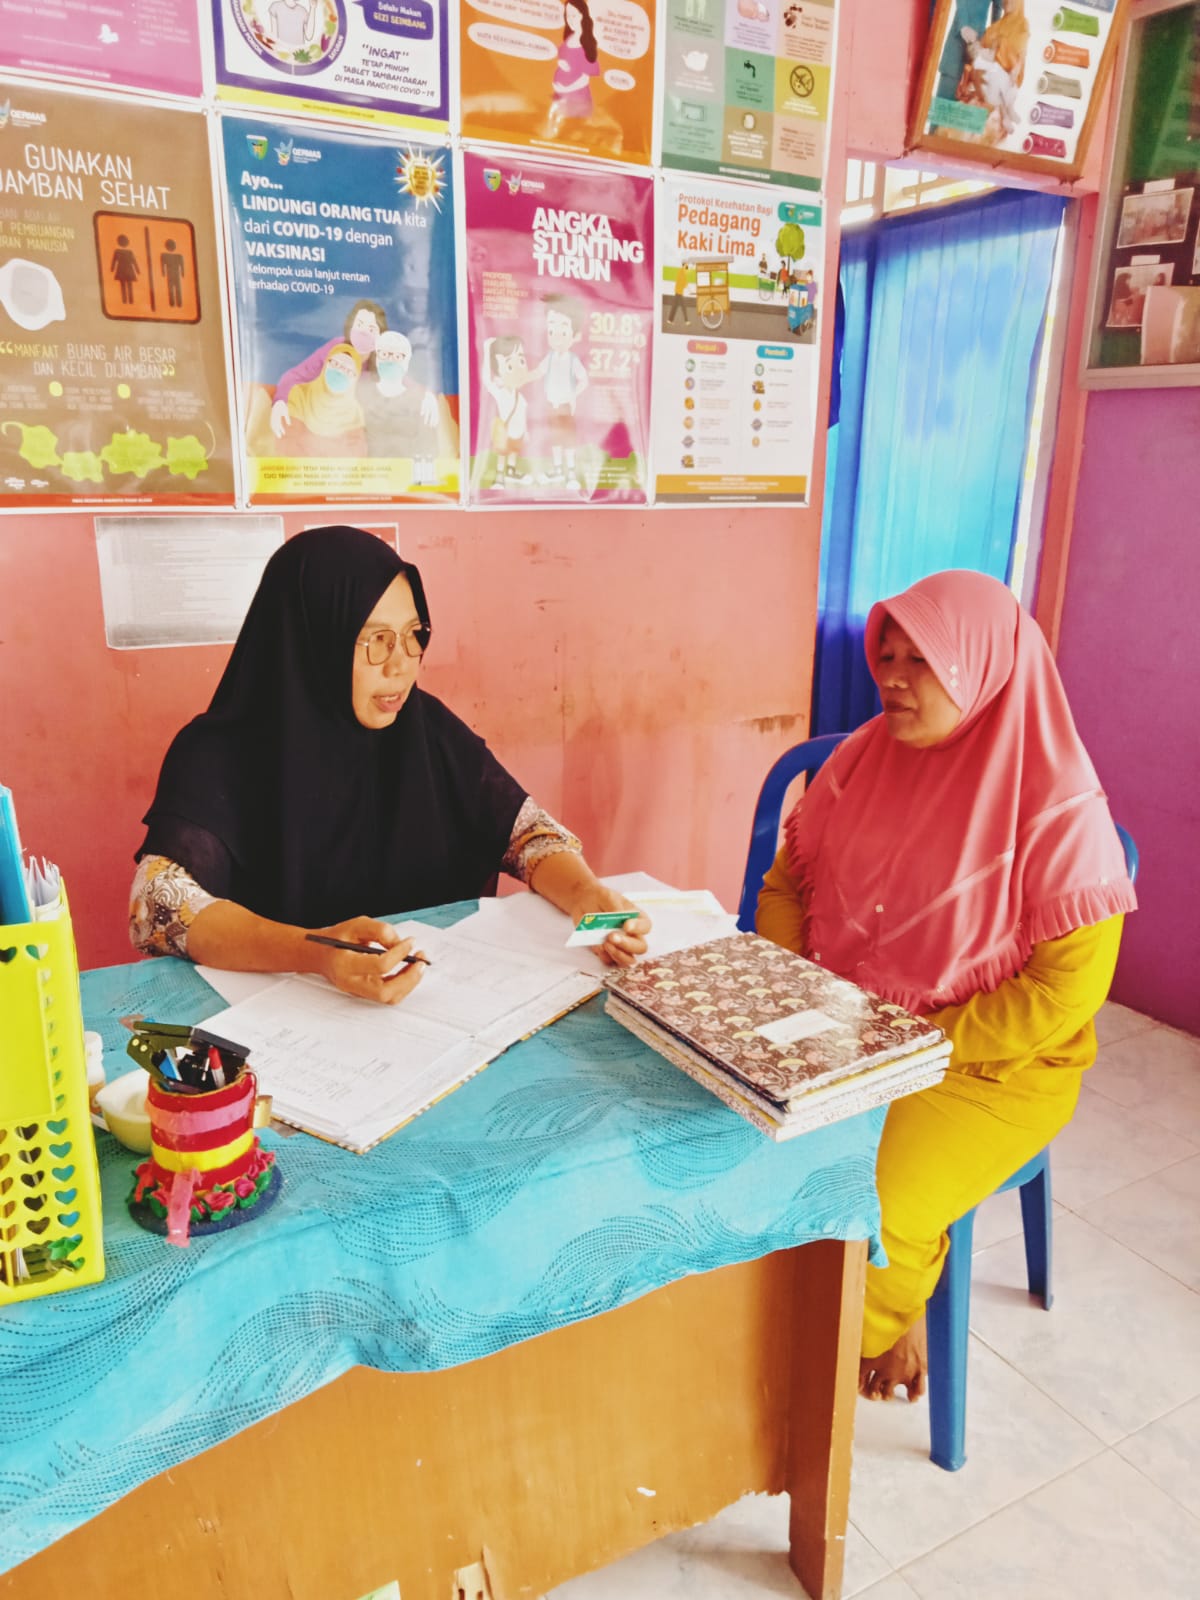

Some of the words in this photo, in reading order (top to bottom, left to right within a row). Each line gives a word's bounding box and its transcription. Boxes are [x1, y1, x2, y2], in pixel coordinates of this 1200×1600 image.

[343, 65, 369, 76] TABLET
[372, 70, 402, 82] TAMBAH
[361, 58, 383, 68] TETAP
[384, 63, 409, 73] MINUM
[344, 76, 365, 86] MASA
[24, 143, 133, 180] GUNAKAN
[241, 171, 284, 190] Ayo...
[100, 180, 171, 210] SEHAT
[679, 193, 714, 207] Protokol
[715, 199, 756, 212] Kesehatan
[756, 204, 774, 216] Bagi
[242, 195, 316, 216] LINDUNGI
[319, 203, 372, 222] ORANG
[374, 208, 402, 225] TUA
[404, 212, 427, 228] kita
[532, 207, 613, 238] ANGKA
[677, 203, 762, 238] Pedagang
[244, 218, 270, 235] dari
[273, 221, 343, 241] COVID-19
[345, 229, 393, 249] dengan
[677, 229, 713, 252] Kaki
[717, 235, 756, 257] Lima
[245, 241, 326, 262] VAKSINASI
[532, 230, 645, 264] STUNTING
[247, 263, 293, 278] Kelompok
[295, 267, 313, 278] usia
[314, 268, 340, 281] lanjut
[341, 272, 370, 283] rentan
[532, 251, 611, 282] TURUN
[291, 281, 334, 295] COVID-19
[66, 344, 107, 361] BUANG
[114, 346, 133, 361] AIR
[139, 347, 177, 364] BESAR
[33, 360, 54, 376] DAN
[61, 361, 96, 378] KECIL
